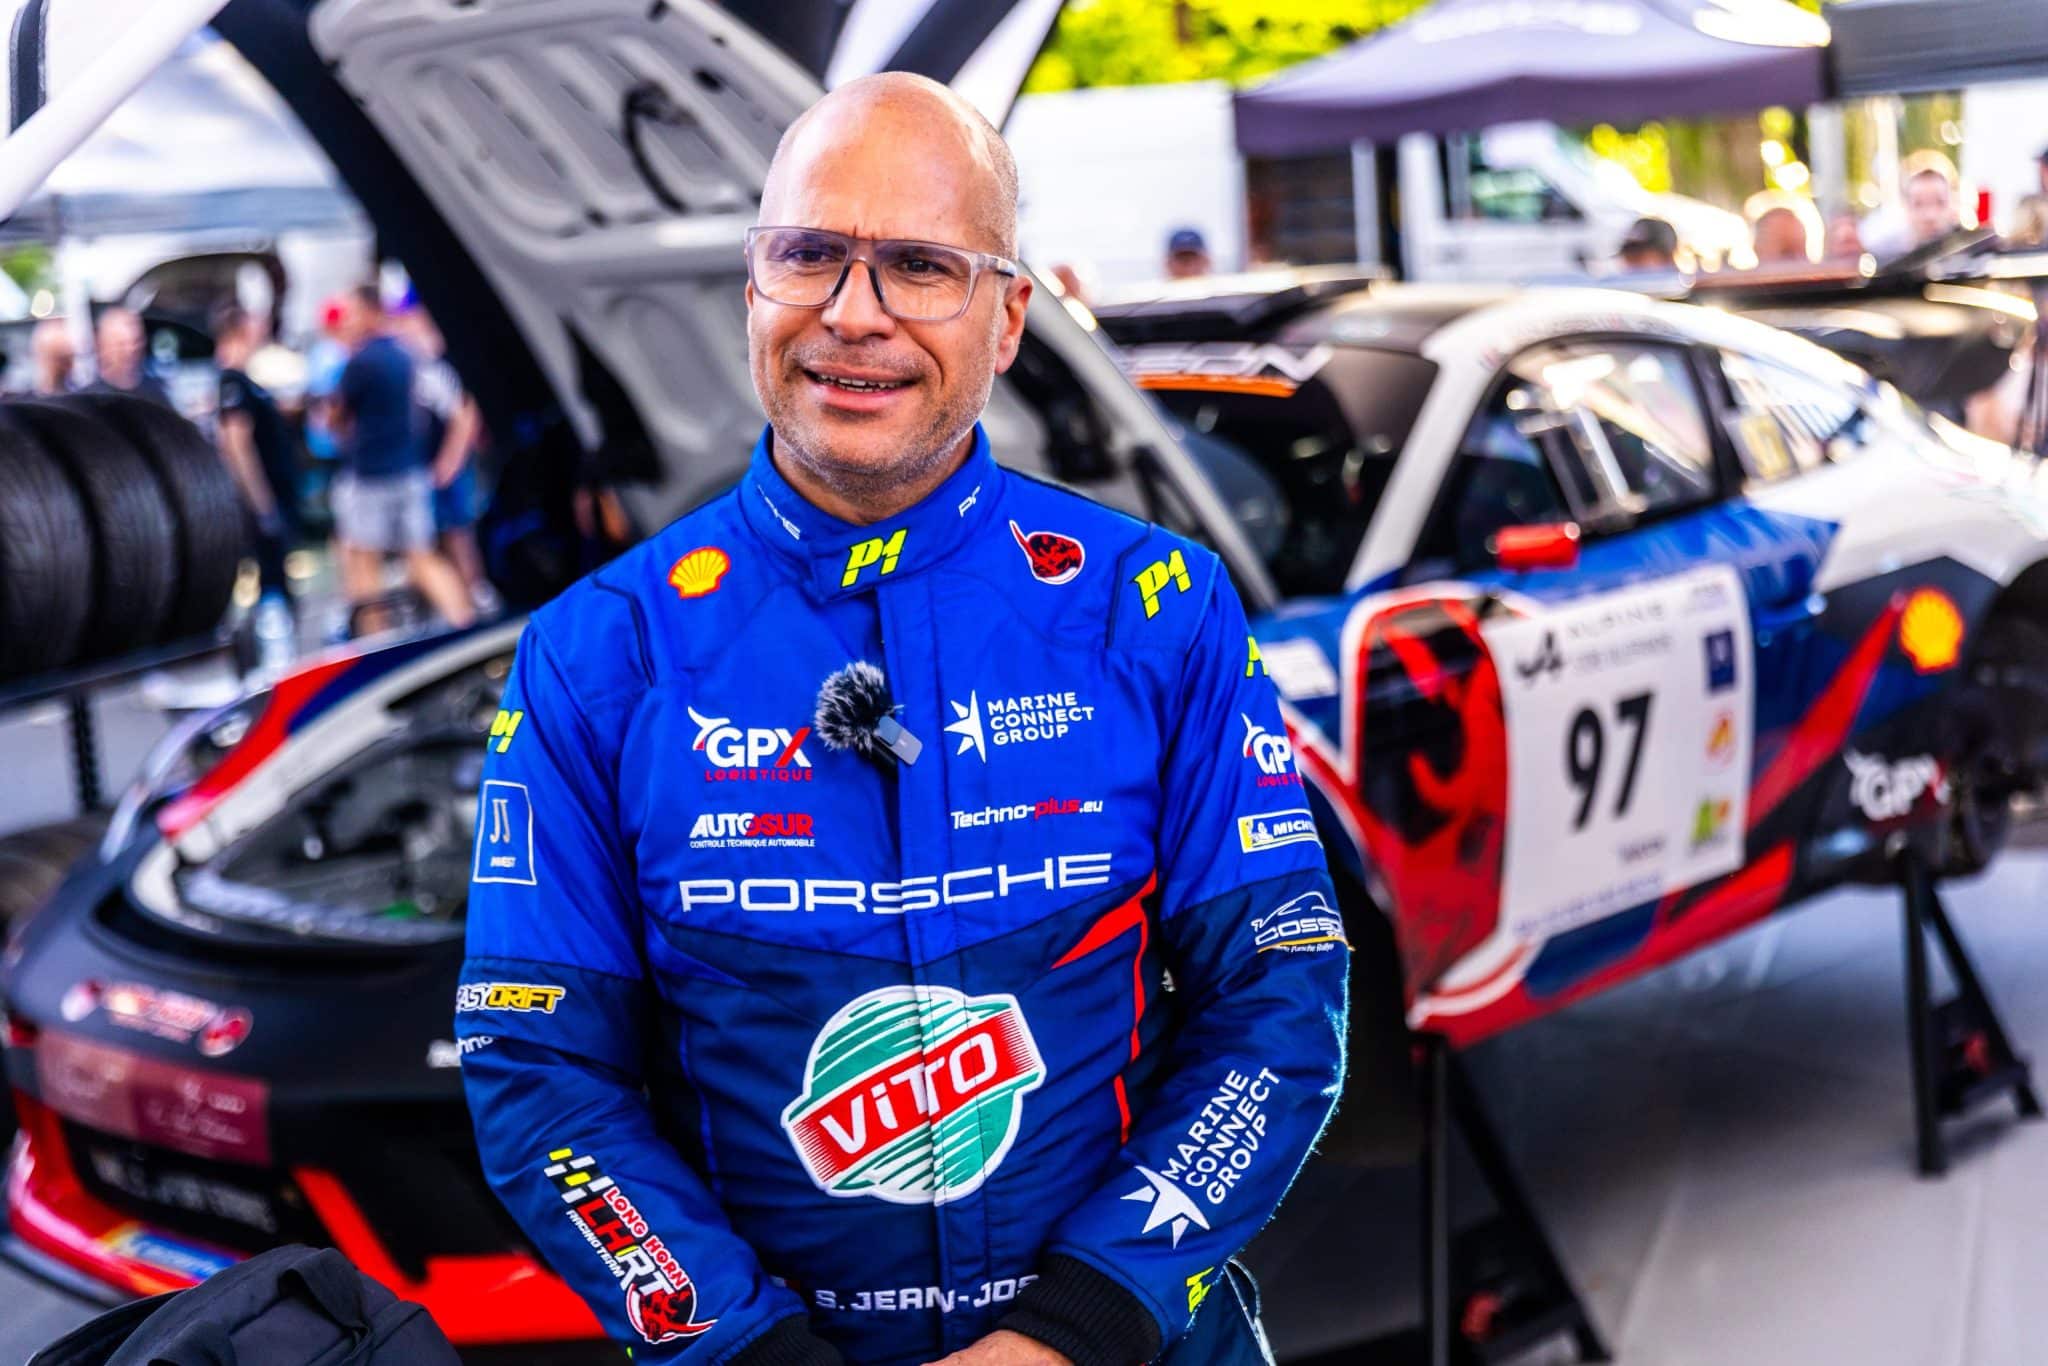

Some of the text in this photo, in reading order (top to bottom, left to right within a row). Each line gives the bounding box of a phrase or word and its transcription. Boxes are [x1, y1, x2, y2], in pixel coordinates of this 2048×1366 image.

[841, 528, 908, 588] P1
[1133, 550, 1192, 619] P1
[986, 691, 1078, 716] MARINE
[989, 706, 1095, 731] CONNECT
[705, 726, 813, 768] GPX
[993, 724, 1070, 746] GROUP
[1253, 733, 1301, 777] GP
[1566, 690, 1654, 833] 97
[689, 812, 815, 838] AUTOSUR
[950, 798, 1103, 829] Techno-plus.eu
[679, 853, 1112, 915] PORSCHE
[457, 984, 565, 1013] ASYDRIFT
[1160, 1069, 1250, 1181] MARINE
[1185, 1067, 1281, 1187] CONNECT
[1206, 1114, 1268, 1205] GROUP
[566, 1209, 627, 1279] RACING TEAM
[603, 1186, 690, 1290] LONG HORN
